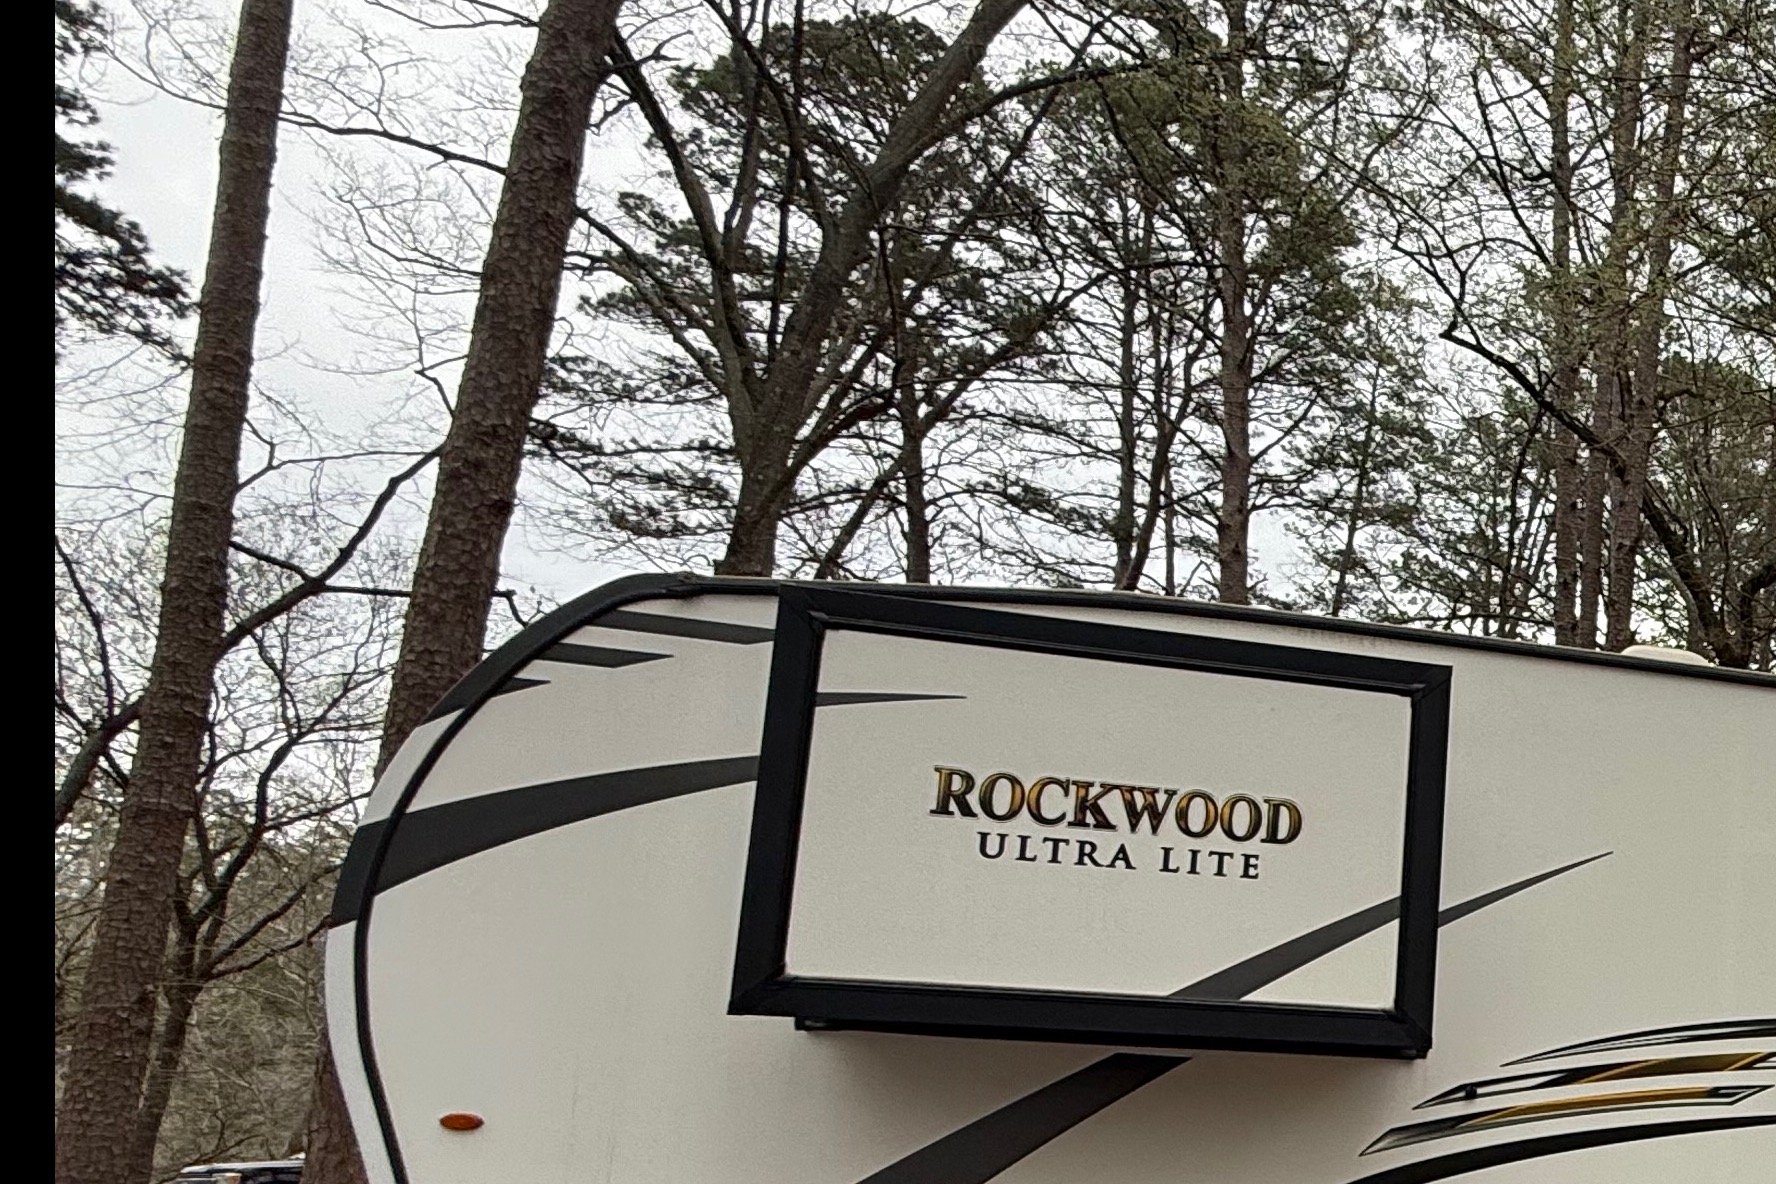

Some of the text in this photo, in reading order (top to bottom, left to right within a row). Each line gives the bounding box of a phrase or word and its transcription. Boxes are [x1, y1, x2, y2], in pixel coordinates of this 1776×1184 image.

[930, 765, 1303, 845] ROCKWOOD
[976, 831, 1261, 880] ULTRA LITE
